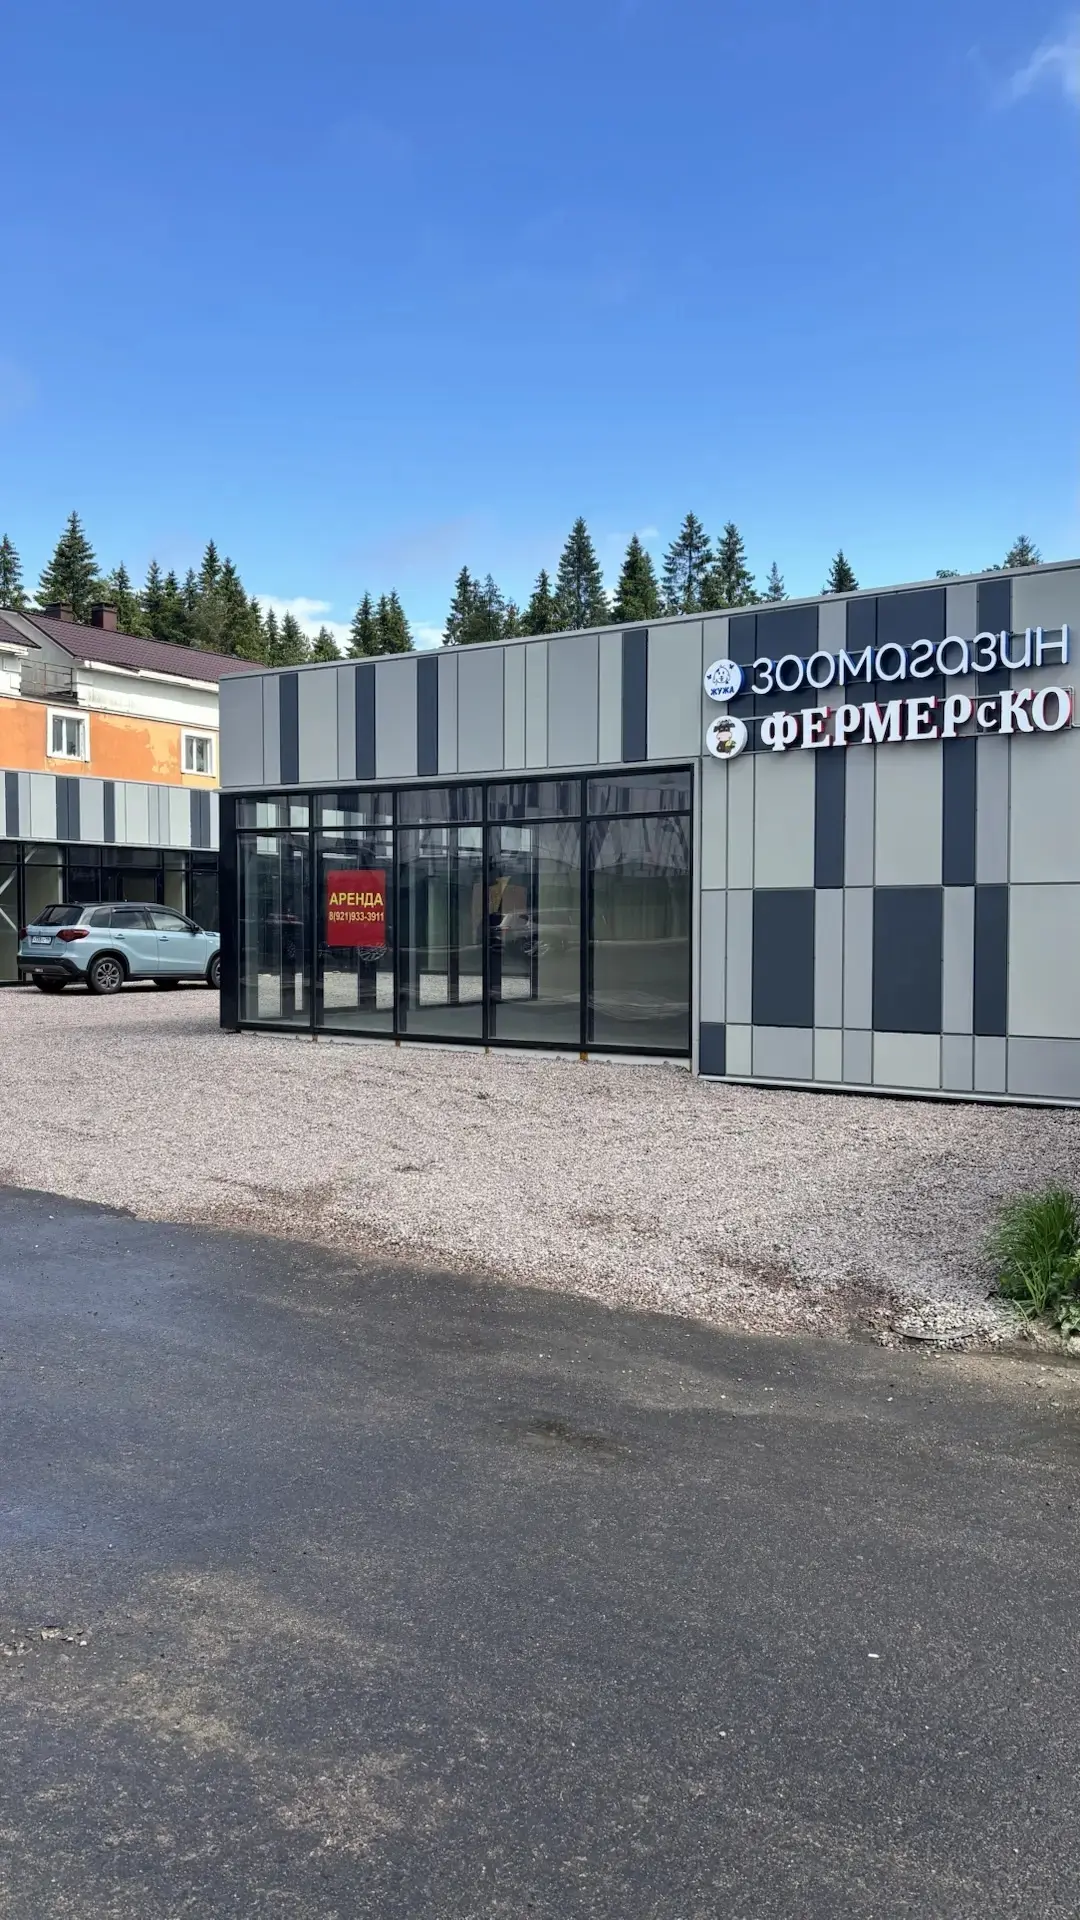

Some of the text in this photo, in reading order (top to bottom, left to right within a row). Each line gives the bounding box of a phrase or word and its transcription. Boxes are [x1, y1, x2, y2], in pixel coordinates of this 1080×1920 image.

[710, 686, 735, 696] ЖУЖА
[329, 892, 384, 908] АРЕНДА
[328, 911, 385, 923] 8(921)933-3911
